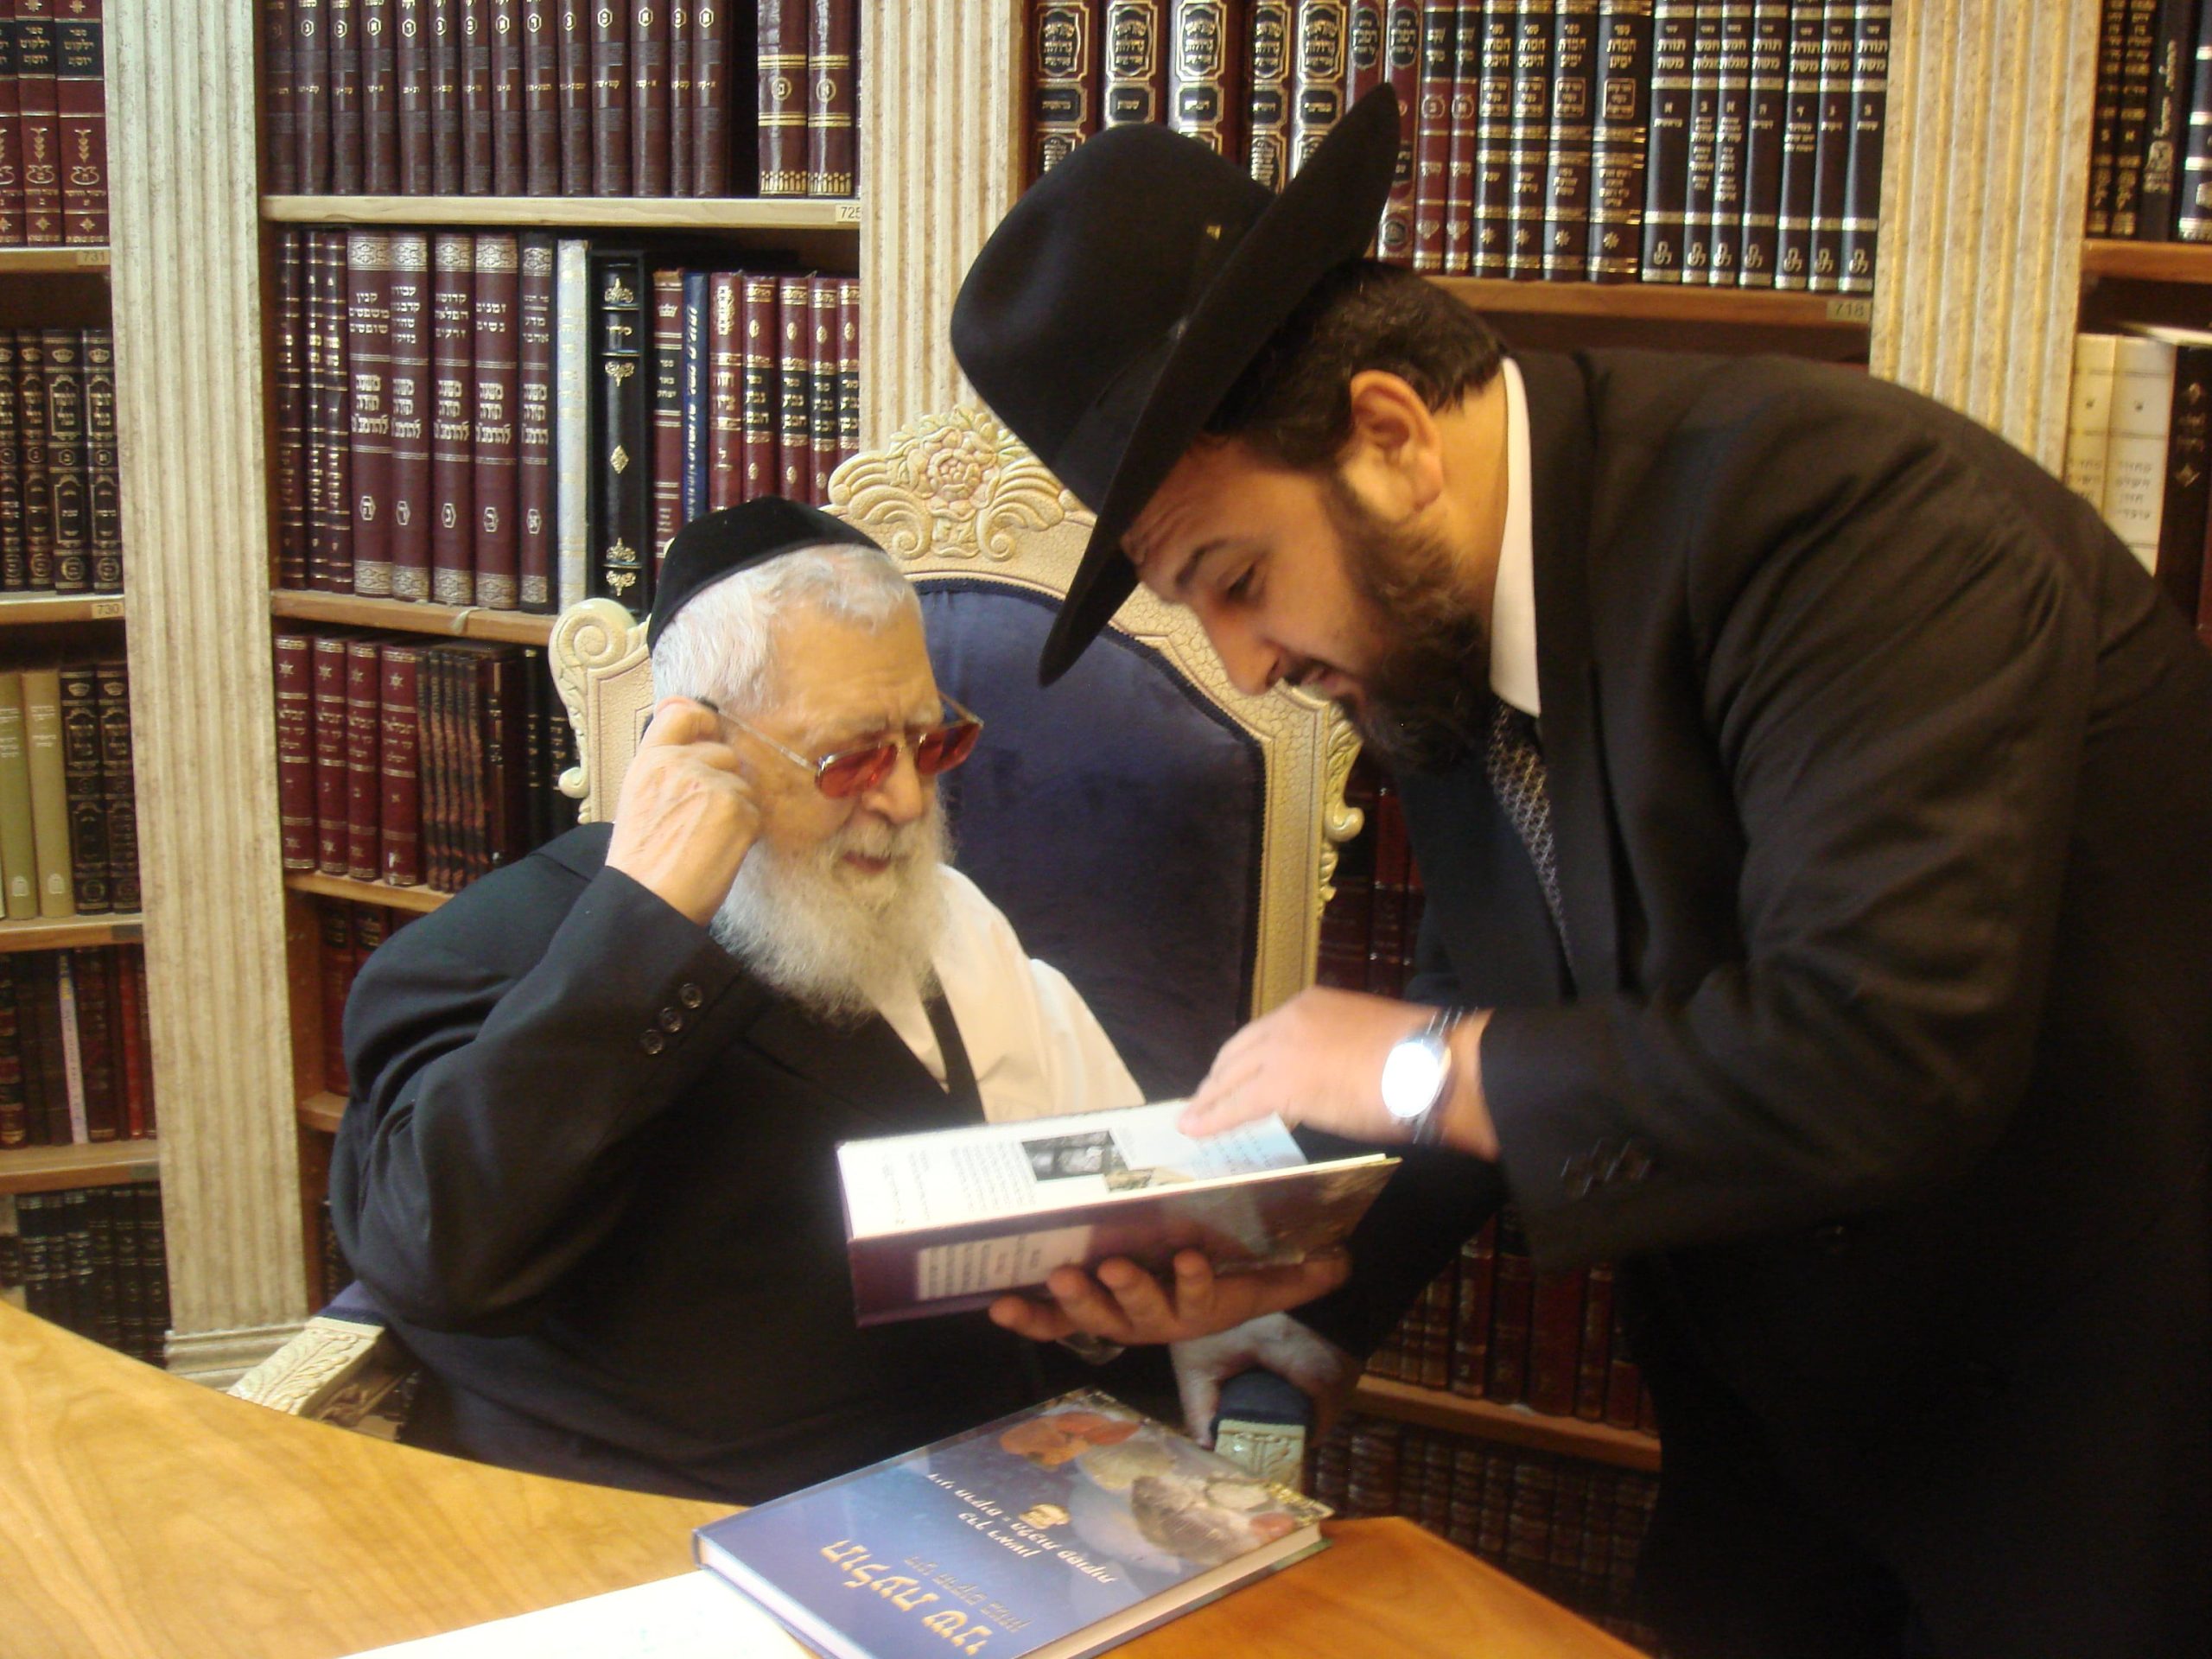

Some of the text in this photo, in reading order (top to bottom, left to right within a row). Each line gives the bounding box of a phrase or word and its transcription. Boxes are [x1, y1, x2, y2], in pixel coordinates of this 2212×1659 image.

[20, 37, 51, 48] ילקוט
[64, 39, 94, 51] ילקוט
[1657, 38, 1686, 52] תורת
[1695, 39, 1719, 52] חמש
[1722, 38, 1746, 51] חמש
[1752, 38, 1783, 52] תורת
[1790, 41, 1821, 54] תורת
[1822, 39, 1853, 54] תורת
[1858, 39, 1888, 54] תורת
[22, 54, 48, 63] יוסף
[68, 55, 92, 66] יוסף
[1657, 56, 1684, 69] משה
[1719, 53, 1748, 69] מגלות
[1752, 56, 1780, 70] משה
[1821, 58, 1850, 72] משה
[1858, 58, 1886, 72] משה
[1790, 59, 1819, 73] משה
[1664, 102, 1673, 113] א
[1726, 101, 1735, 112] א
[356, 293, 378, 303] קנין
[348, 308, 390, 318] משפטים
[391, 302, 420, 313] קרבנ
[476, 302, 506, 313] זמנים
[1835, 302, 1865, 317] 718
[349, 323, 388, 334] שופטים
[477, 321, 505, 332] נשים
[524, 316, 546, 327] מדע
[391, 334, 416, 344] נזיק
[435, 327, 467, 339] זרעים
[356, 374, 381, 391] משנה
[438, 380, 462, 397] משנה
[479, 383, 504, 400] משנה
[524, 384, 548, 401] משנה
[356, 395, 379, 411] תורה
[438, 400, 461, 417] תורה
[480, 403, 502, 421] תורה
[524, 404, 547, 421] תורה
[928, 1473, 955, 1490] דיני
[954, 1489, 1004, 1516] חרקים
[1010, 1522, 1062, 1552] הלכות
[1056, 1549, 1118, 1583] פסוקות
[958, 1512, 1042, 1558] כרך ראשון
[821, 1540, 993, 1656] תולעת שני
[905, 1556, 1032, 1632] דיני חרקים במזון
